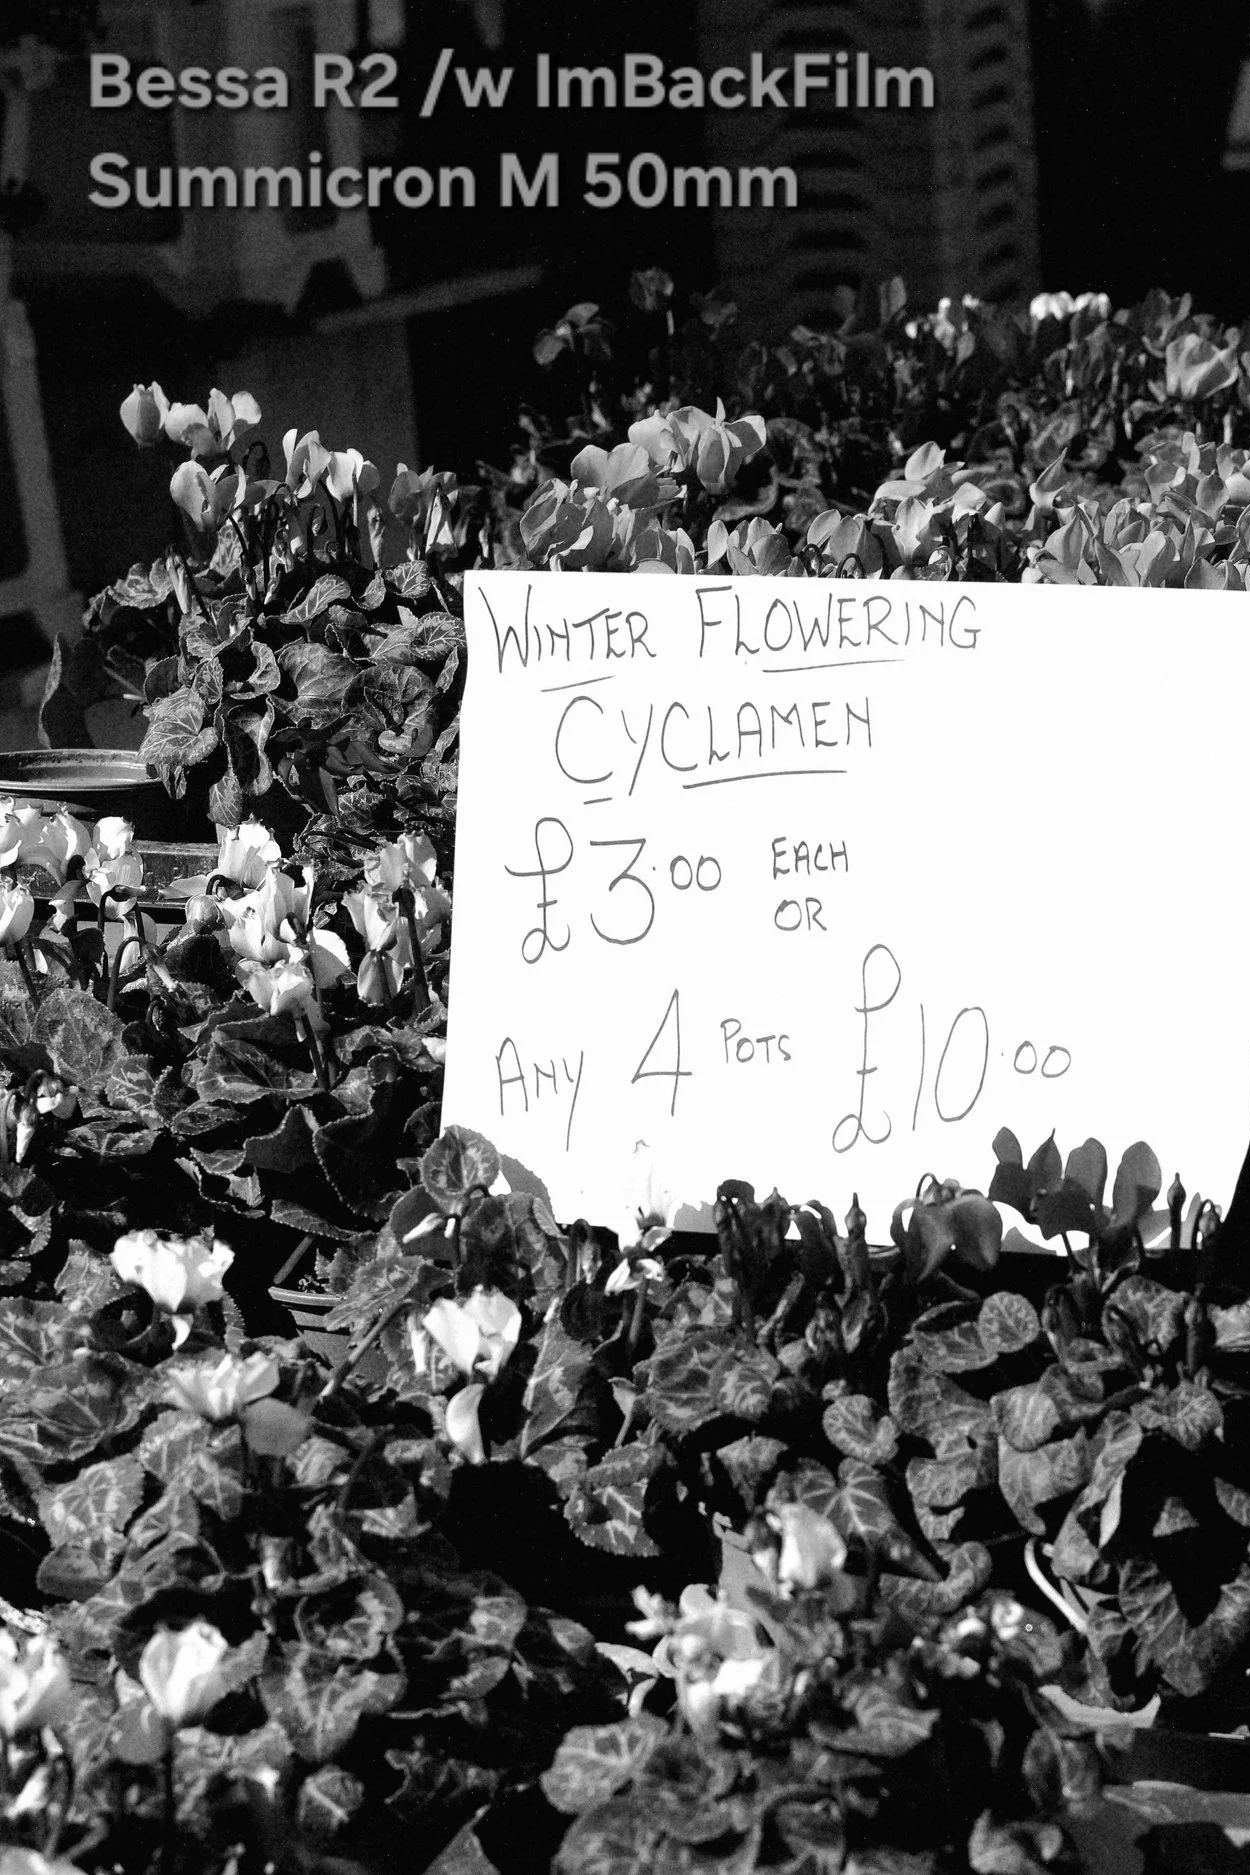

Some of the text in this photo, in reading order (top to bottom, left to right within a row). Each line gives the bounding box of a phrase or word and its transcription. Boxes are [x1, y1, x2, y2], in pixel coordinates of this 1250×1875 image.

[478, 584, 981, 673] WINTER FLOWERING
[555, 696, 871, 796] CYCLAMEN
[772, 837, 848, 880] EACH
[775, 897, 827, 931] OR
[486, 1037, 583, 1152] ANY
[631, 989, 692, 1116] 4
[721, 1019, 792, 1063] POTS
